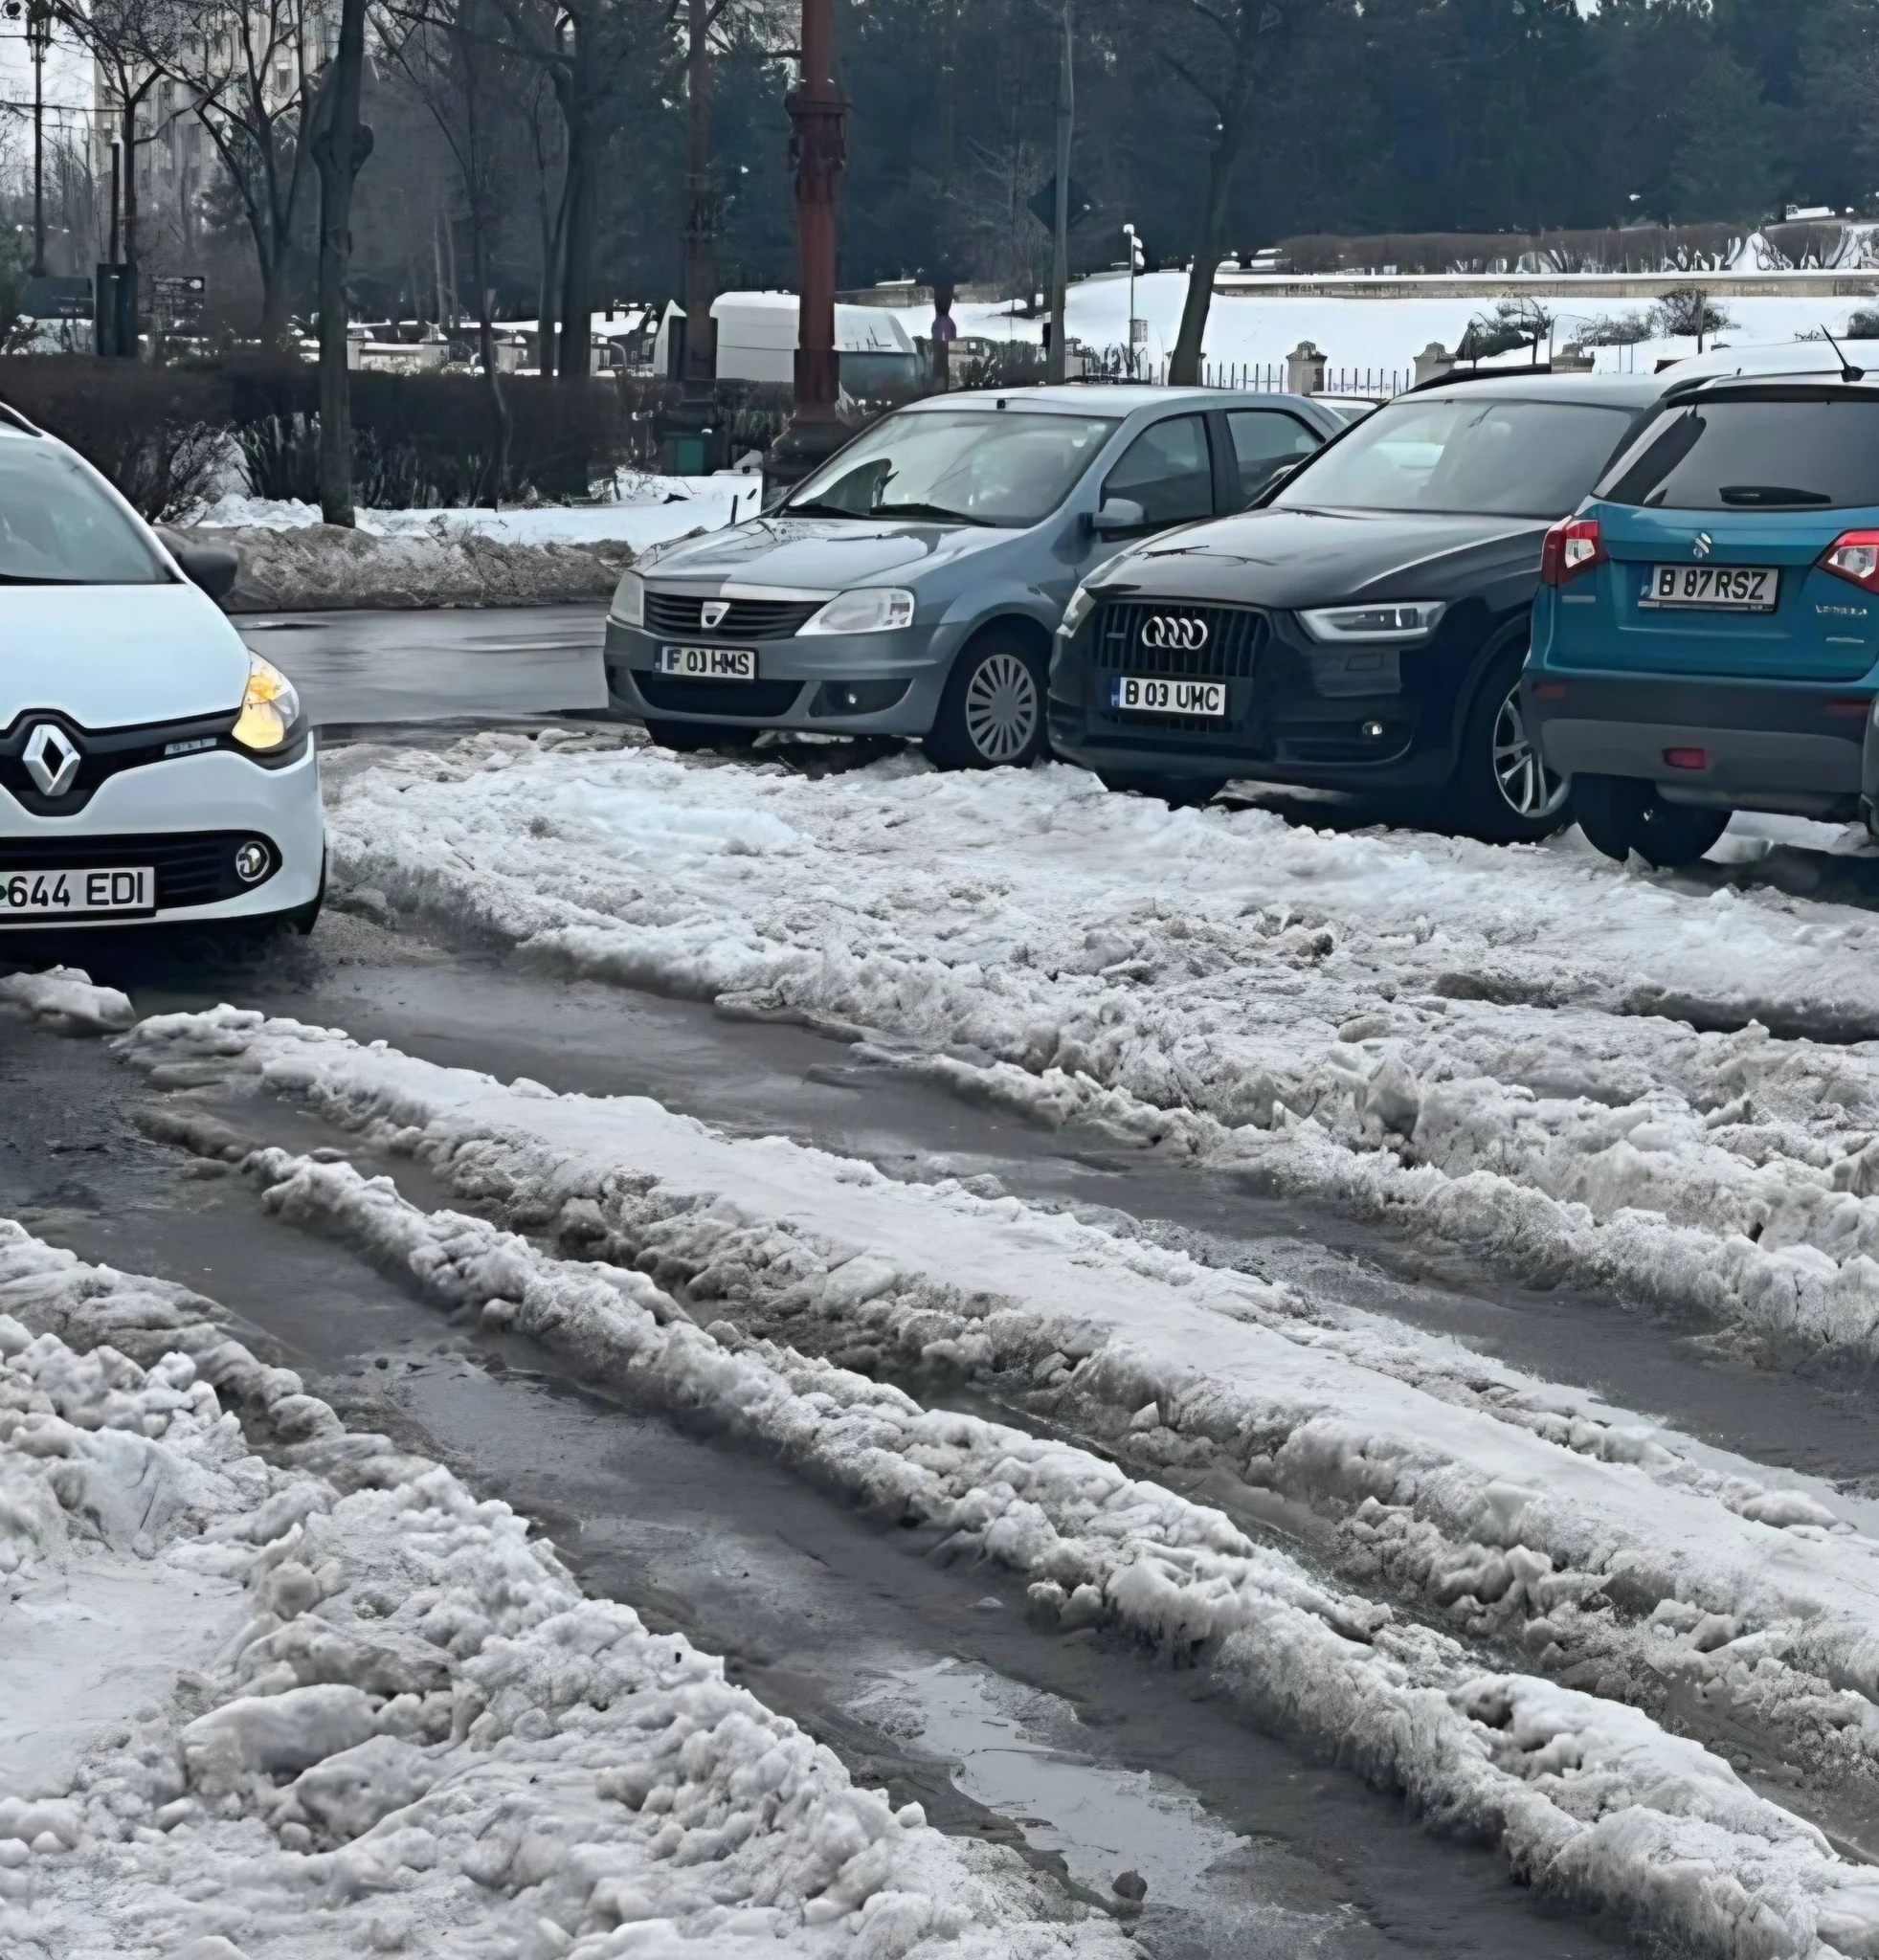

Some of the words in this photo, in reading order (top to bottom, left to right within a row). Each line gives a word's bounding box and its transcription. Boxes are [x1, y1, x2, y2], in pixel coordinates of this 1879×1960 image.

[1659, 569, 1676, 596] B
[1125, 680, 1140, 705] B
[1145, 682, 1169, 707] 03
[9, 873, 71, 907] 644
[86, 872, 144, 905] EDI
